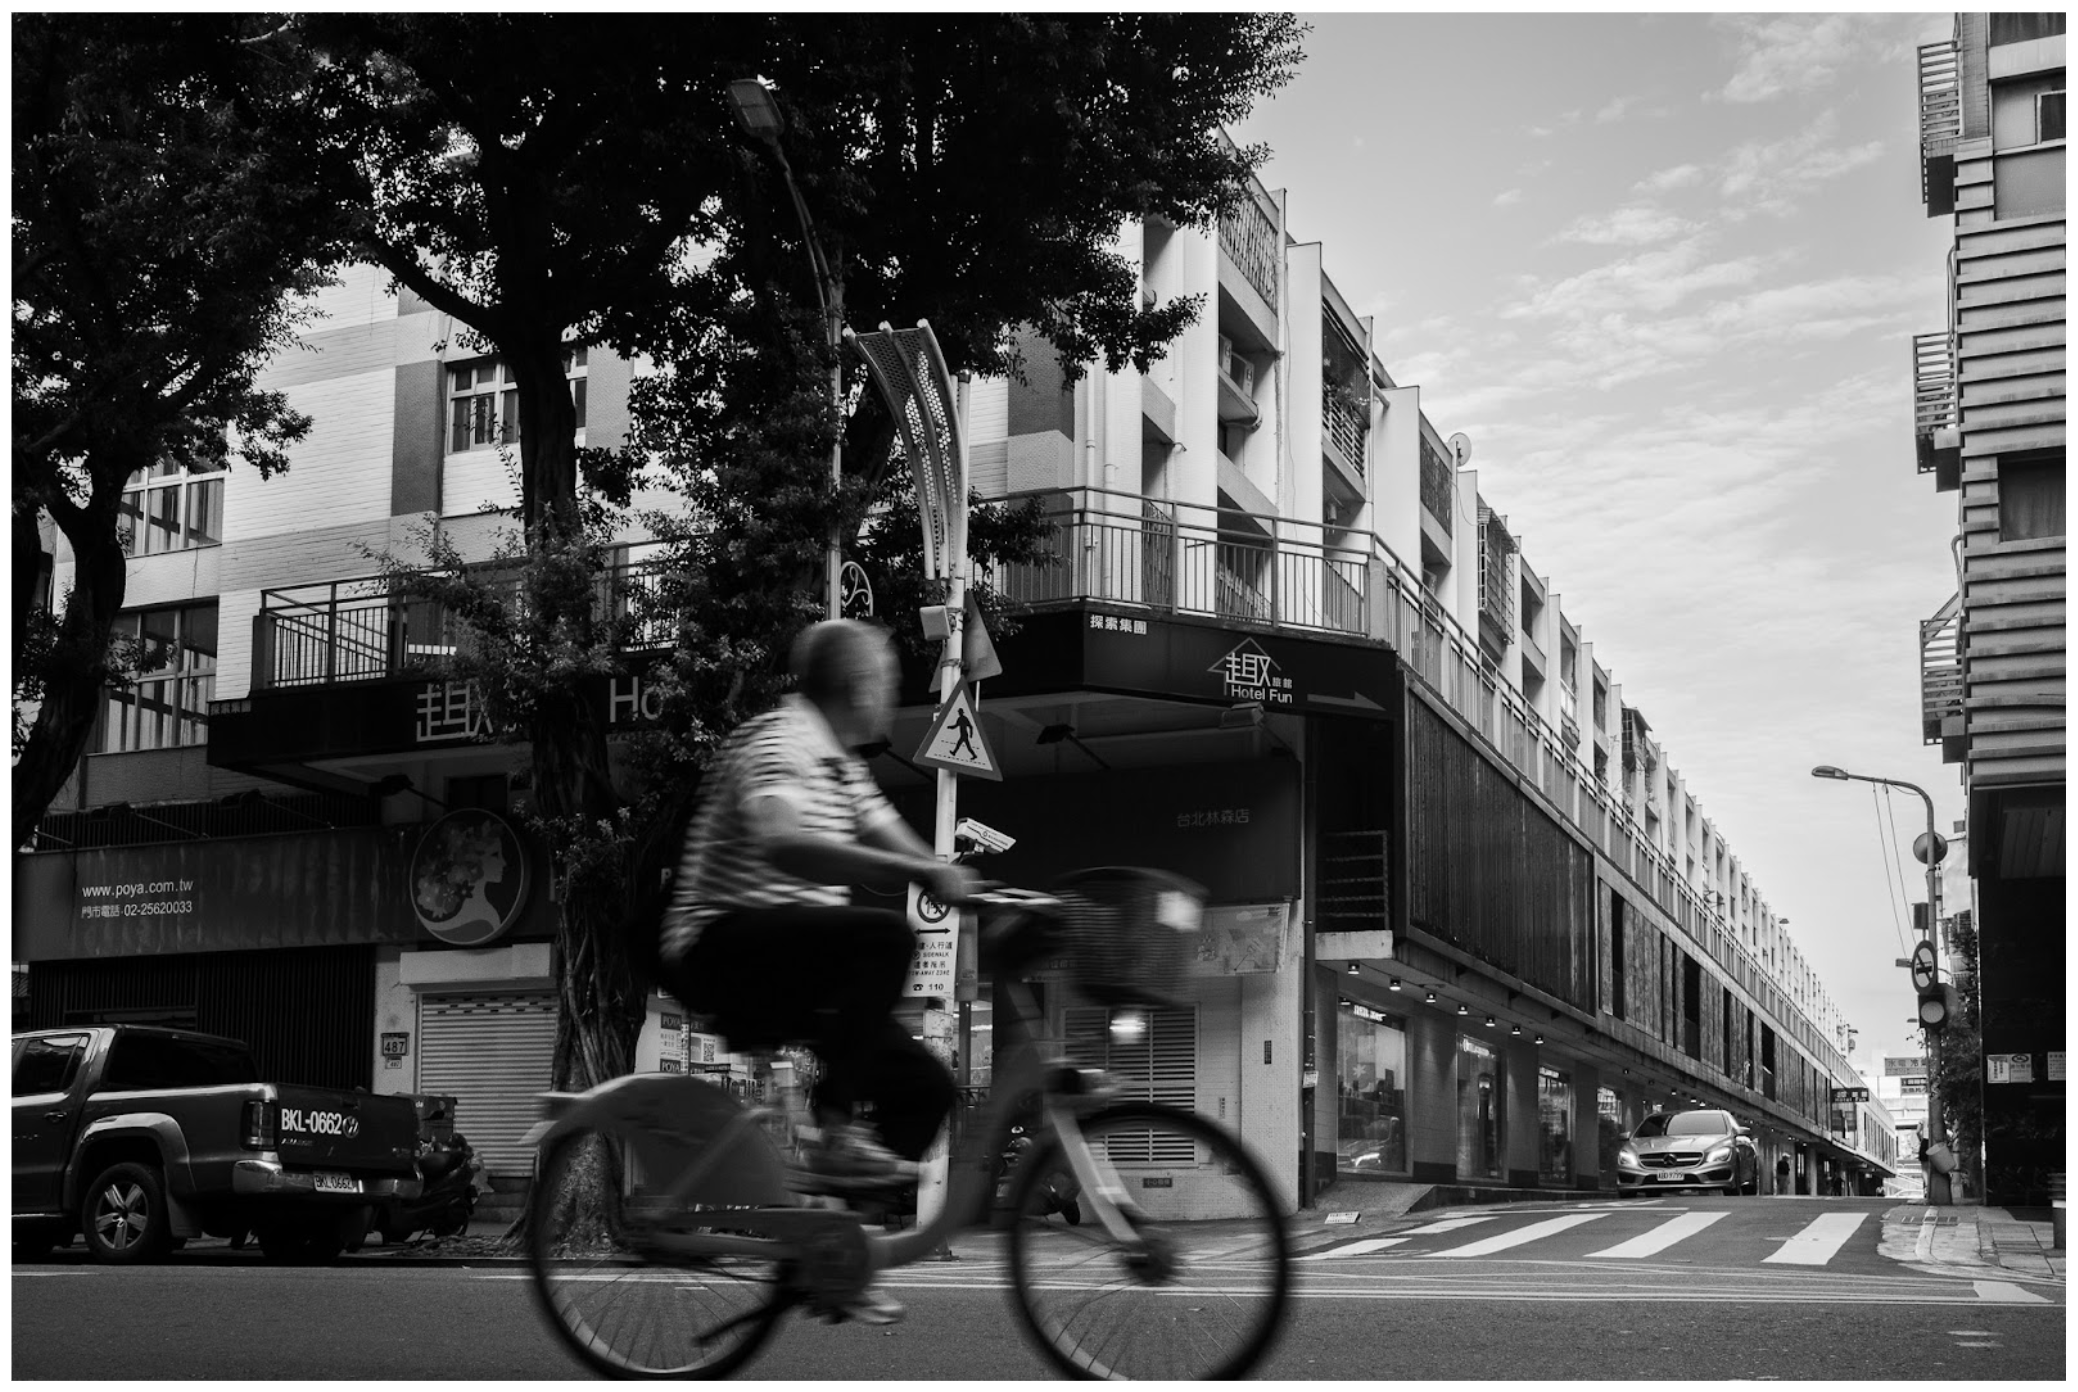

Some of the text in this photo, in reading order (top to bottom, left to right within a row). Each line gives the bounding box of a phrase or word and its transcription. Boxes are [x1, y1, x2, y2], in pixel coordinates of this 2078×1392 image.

[1090, 614, 1147, 635] 探索集團
[1225, 652, 1271, 687] 趣
[1231, 685, 1293, 704] Hotel Fun
[1177, 808, 1250, 828] 台北林森店
[82, 879, 193, 898] www.poya.com.tw
[928, 983, 945, 991] 110
[385, 1041, 405, 1053] 487
[662, 1061, 681, 1073] POYA
[281, 1108, 342, 1135] BKL-0662
